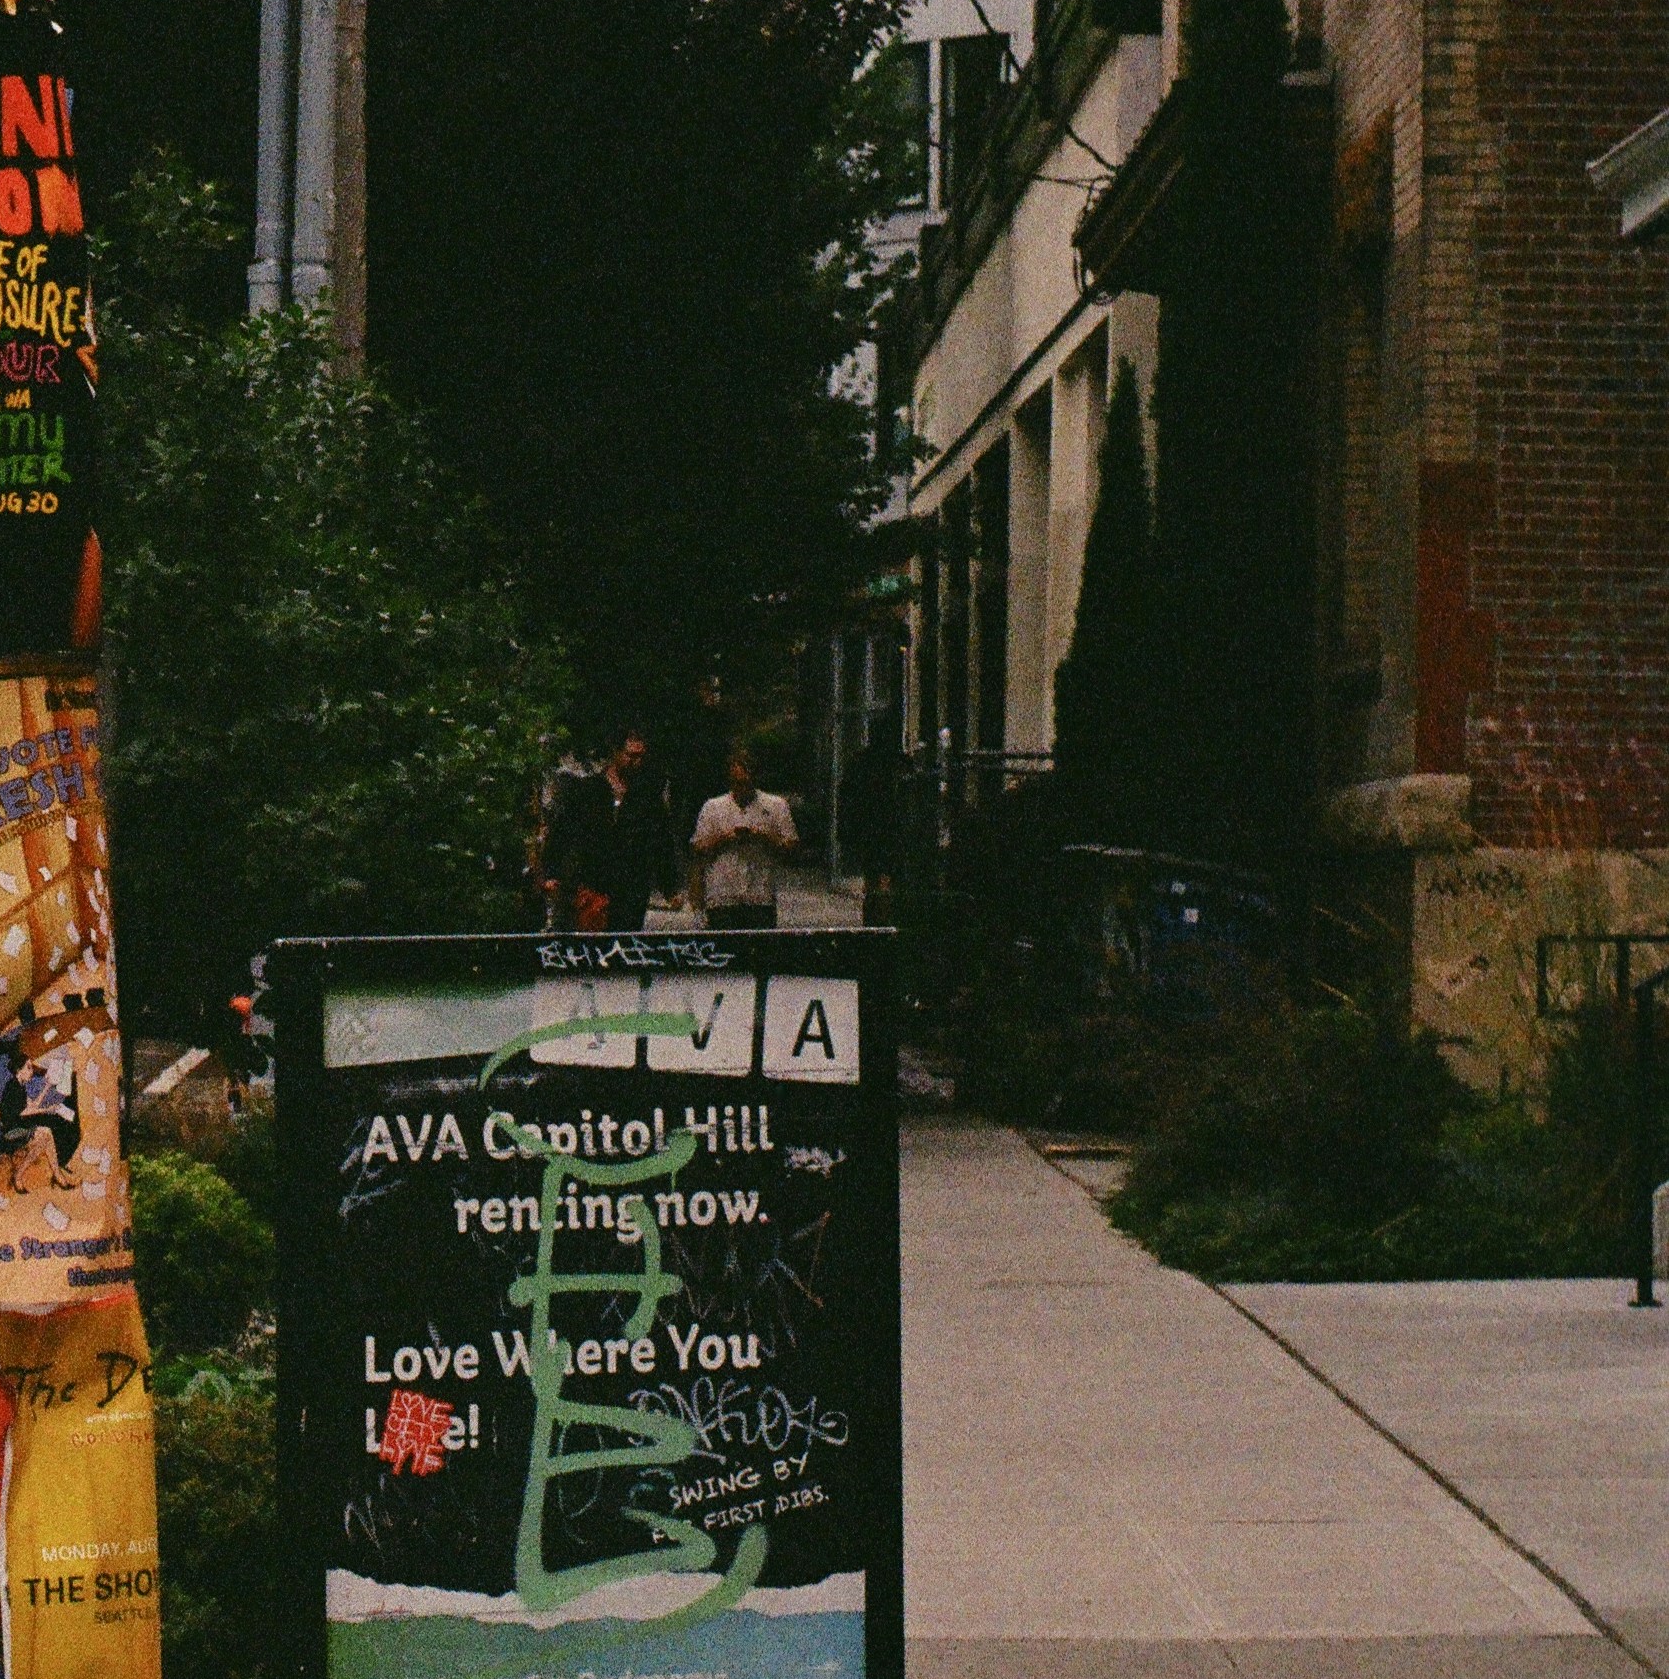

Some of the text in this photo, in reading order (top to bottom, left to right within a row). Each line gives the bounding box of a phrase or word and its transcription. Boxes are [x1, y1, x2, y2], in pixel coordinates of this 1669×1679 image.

[16, 242, 49, 282] OF
[26, 490, 60, 514] 30
[362, 1114, 469, 1164] AVA
[683, 1104, 774, 1155] Hill
[454, 1182, 770, 1245] rening now.
[364, 1335, 480, 1384] Love
[667, 1323, 763, 1373] You
[364, 1402, 481, 1454] Le!
[668, 1451, 810, 1510] SWING BY
[703, 1498, 767, 1530] FIRST
[22, 1574, 86, 1608] THE
